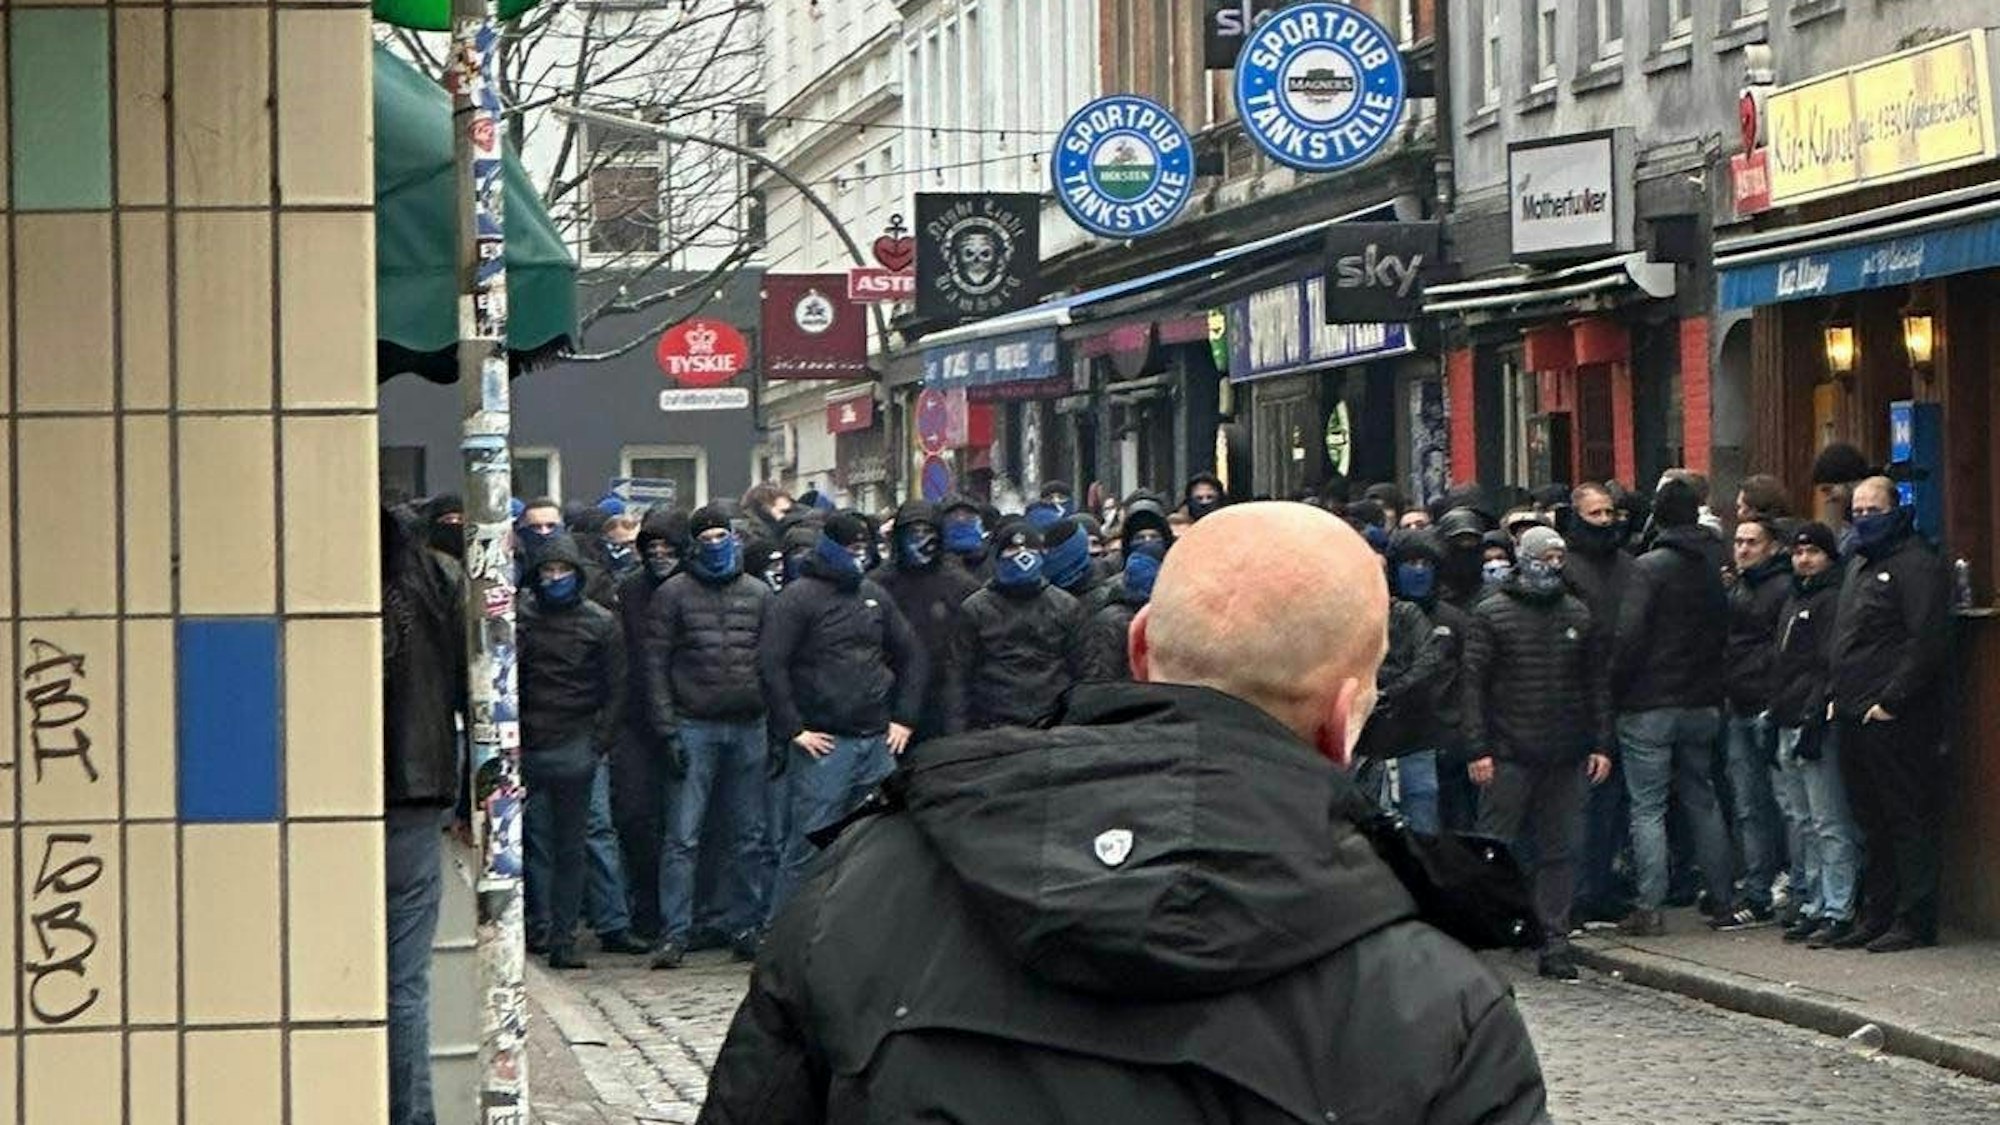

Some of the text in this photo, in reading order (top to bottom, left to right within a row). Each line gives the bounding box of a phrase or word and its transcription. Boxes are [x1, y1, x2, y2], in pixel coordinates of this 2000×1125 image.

[1216, 0, 1271, 36] sk
[1251, 12, 1390, 70] SPORTPUB
[1066, 104, 1182, 155] SPORTPUB
[1248, 89, 1393, 159] TANKSTELLE
[1064, 170, 1186, 228] TANKSTELLE
[856, 275, 915, 292] ASTR
[1336, 243, 1424, 298] sky
[665, 353, 739, 374] TYSKIE
